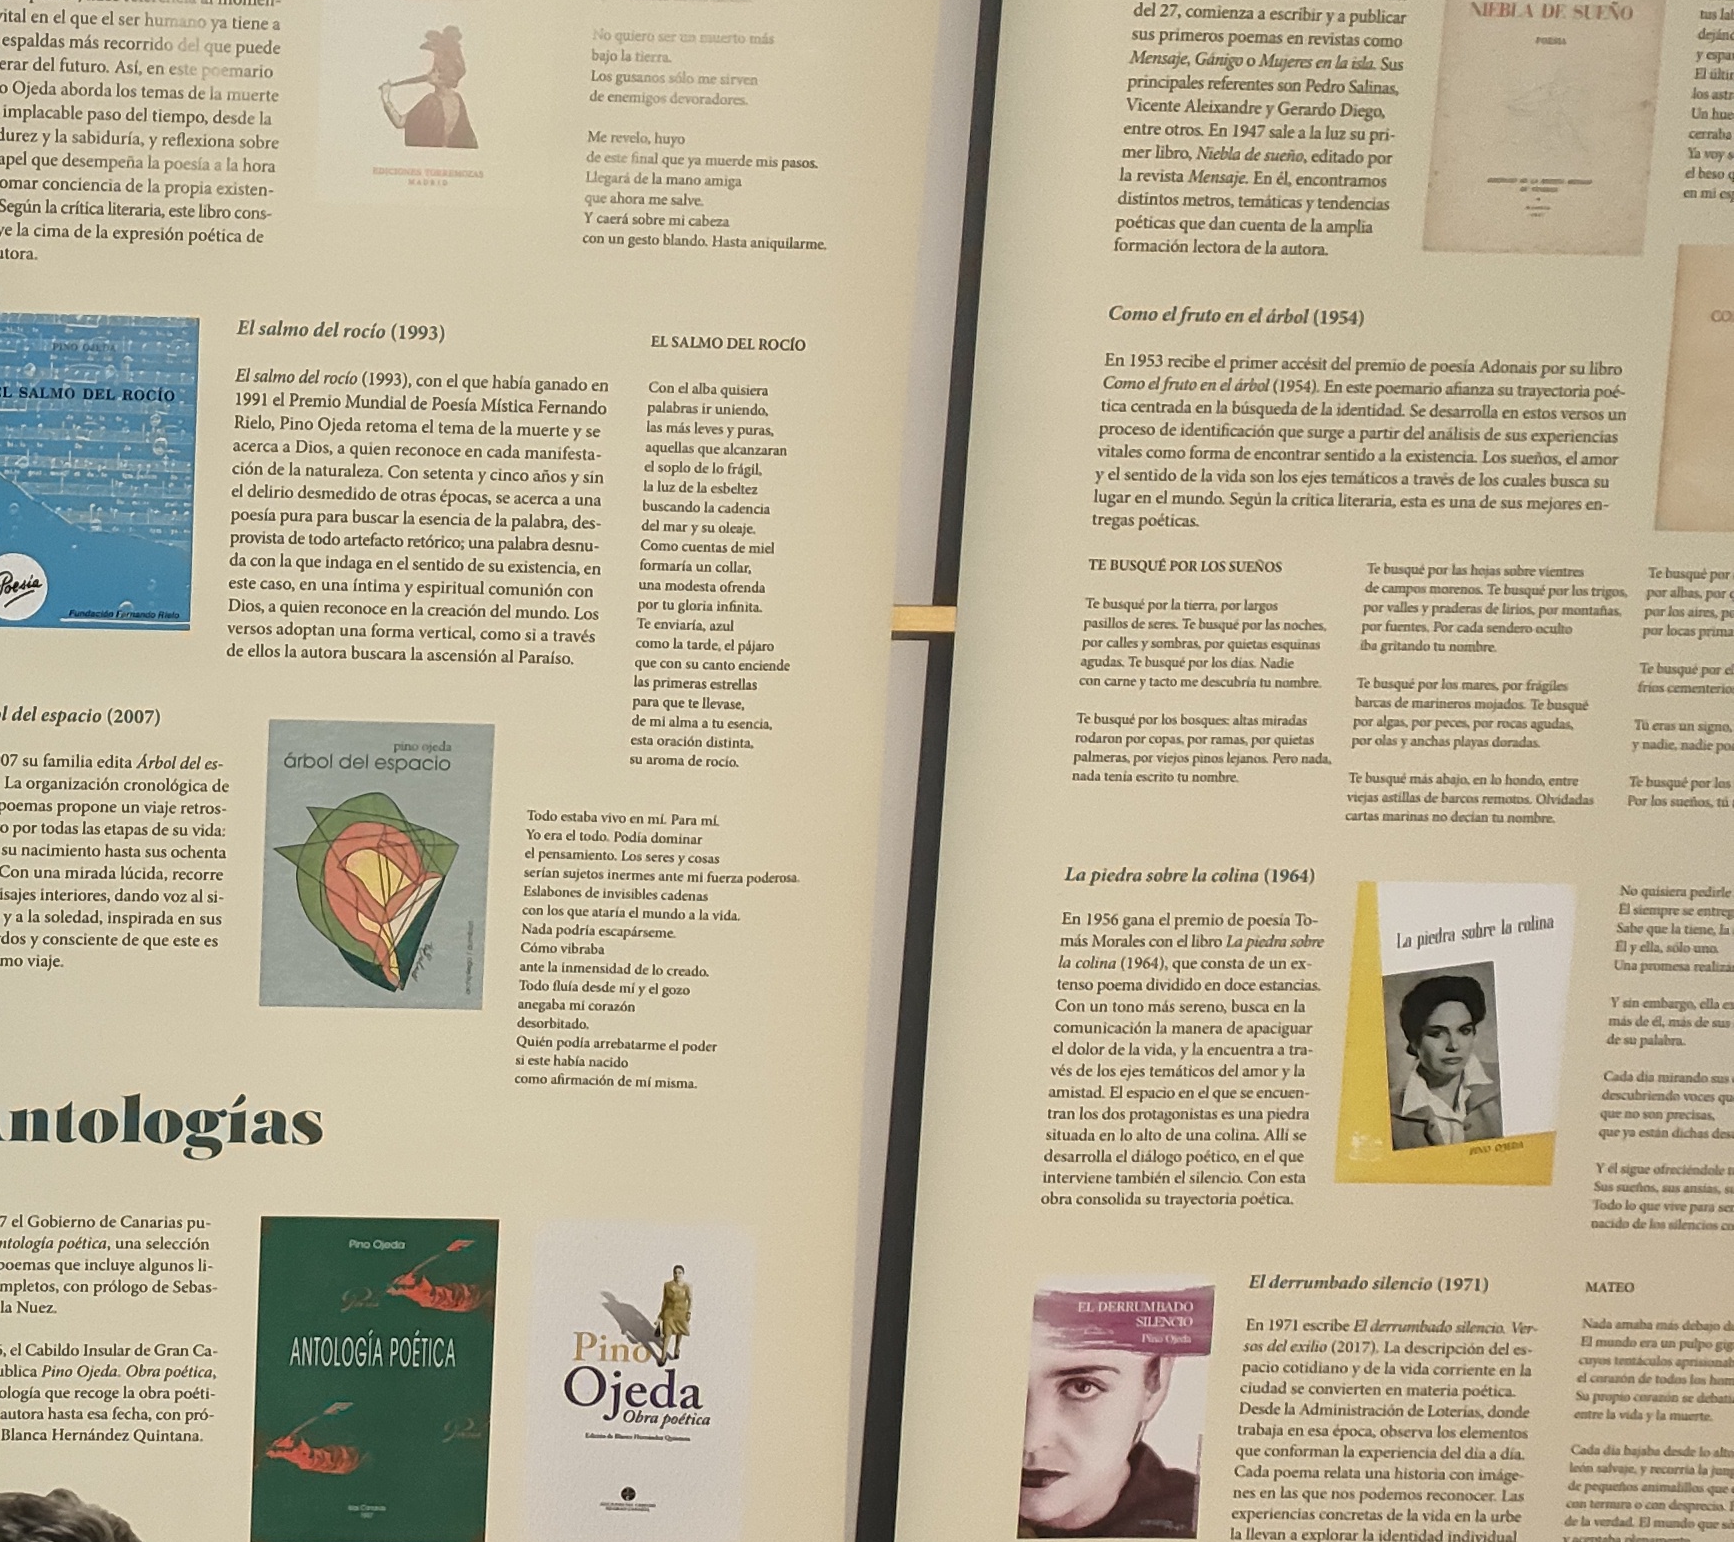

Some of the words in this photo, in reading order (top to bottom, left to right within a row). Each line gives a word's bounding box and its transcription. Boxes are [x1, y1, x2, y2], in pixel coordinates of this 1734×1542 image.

[1471, 1, 1534, 18] NIEBLA
[1541, 2, 1566, 20] DE
[1574, 0, 1634, 20] SUEÑO
[373, 167, 421, 176] EDICIONES
[1113, 236, 1189, 254] formación
[1192, 238, 1241, 255] lectora
[1243, 239, 1262, 255] de
[1263, 239, 1278, 256] la
[1279, 243, 1329, 257] autora.
[1108, 304, 1159, 322] Como
[1161, 305, 1178, 323] el
[1175, 305, 1222, 327] fruto
[1224, 311, 1245, 324] en
[1247, 306, 1264, 324] el
[1265, 307, 1310, 325] árbol
[1312, 308, 1365, 328] (1954)
[235, 318, 256, 336] El
[257, 319, 310, 338] salmo
[312, 320, 340, 338] del
[342, 322, 387, 340] rocío
[390, 322, 446, 344] (1993)
[52, 343, 78, 352] PINO
[650, 335, 669, 348] EL
[670, 335, 724, 350] SALMO
[726, 337, 756, 351] DEL
[758, 336, 807, 352] ROCÍO
[19, 387, 75, 399] SALMO
[83, 388, 115, 400] DEL
[122, 384, 175, 402] ROCÍO
[648, 380, 675, 394] Con
[677, 381, 689, 395] el
[691, 381, 718, 396] alba
[719, 384, 769, 400] quisiera
[1087, 558, 1107, 571] TE
[1109, 557, 1167, 574] BUSQUÉ
[1168, 559, 1198, 573] POR
[1200, 560, 1227, 573] LOS
[1227, 558, 1283, 574] SUEÑOS
[69, 609, 114, 619] Fundación
[116, 610, 155, 619] Fernando
[158, 610, 180, 619] Rielo
[11, 705, 38, 722] del
[40, 708, 103, 728] espacio
[106, 707, 161, 728] (2007)
[394, 741, 418, 753] pino
[421, 741, 451, 754] ojeda
[284, 752, 333, 769] árbol
[339, 755, 369, 770] del
[375, 756, 451, 773] espacio
[1063, 866, 1087, 882] La
[1088, 866, 1143, 887] piedra
[1145, 866, 1189, 883] sobre
[1191, 866, 1208, 883] la
[1210, 866, 1260, 884] colina
[1263, 867, 1316, 886] (1964)
[1397, 933, 1412, 949] La
[1416, 926, 1456, 950] piedra
[1461, 922, 1496, 941] sobre
[1501, 919, 1513, 935] la
[10, 1213, 24, 1229] el
[26, 1214, 96, 1229] Gobierno
[99, 1214, 118, 1229] de
[119, 1214, 183, 1229] Canarias
[186, 1219, 211, 1234] pu-
[349, 1239, 371, 1249] Pino
[373, 1239, 405, 1251] Ojeda
[1248, 1273, 1267, 1290] El
[1267, 1273, 1369, 1291] derrumbado
[1371, 1274, 1433, 1292] silencio
[1436, 1276, 1489, 1295] (1971)
[1584, 1280, 1636, 1294] MATEO
[1078, 1302, 1094, 1312] EL
[1099, 1302, 1193, 1313] DERRUMBADO
[1136, 1316, 1193, 1327] SILENCIO
[290, 1330, 383, 1367] ANTOLOGÍA
[390, 1330, 455, 1367] POÉTICA
[573, 1331, 651, 1363] Pino
[1142, 1334, 1162, 1344] Pino
[1165, 1334, 1191, 1344] Ojeda
[564, 1365, 703, 1422] Ojeda
[623, 1410, 658, 1425] Obra
[660, 1412, 711, 1429] poética
[0, 1427, 48, 1442] Blanca
[51, 1427, 130, 1442] Hernández
[132, 1428, 204, 1445] Quintana.
